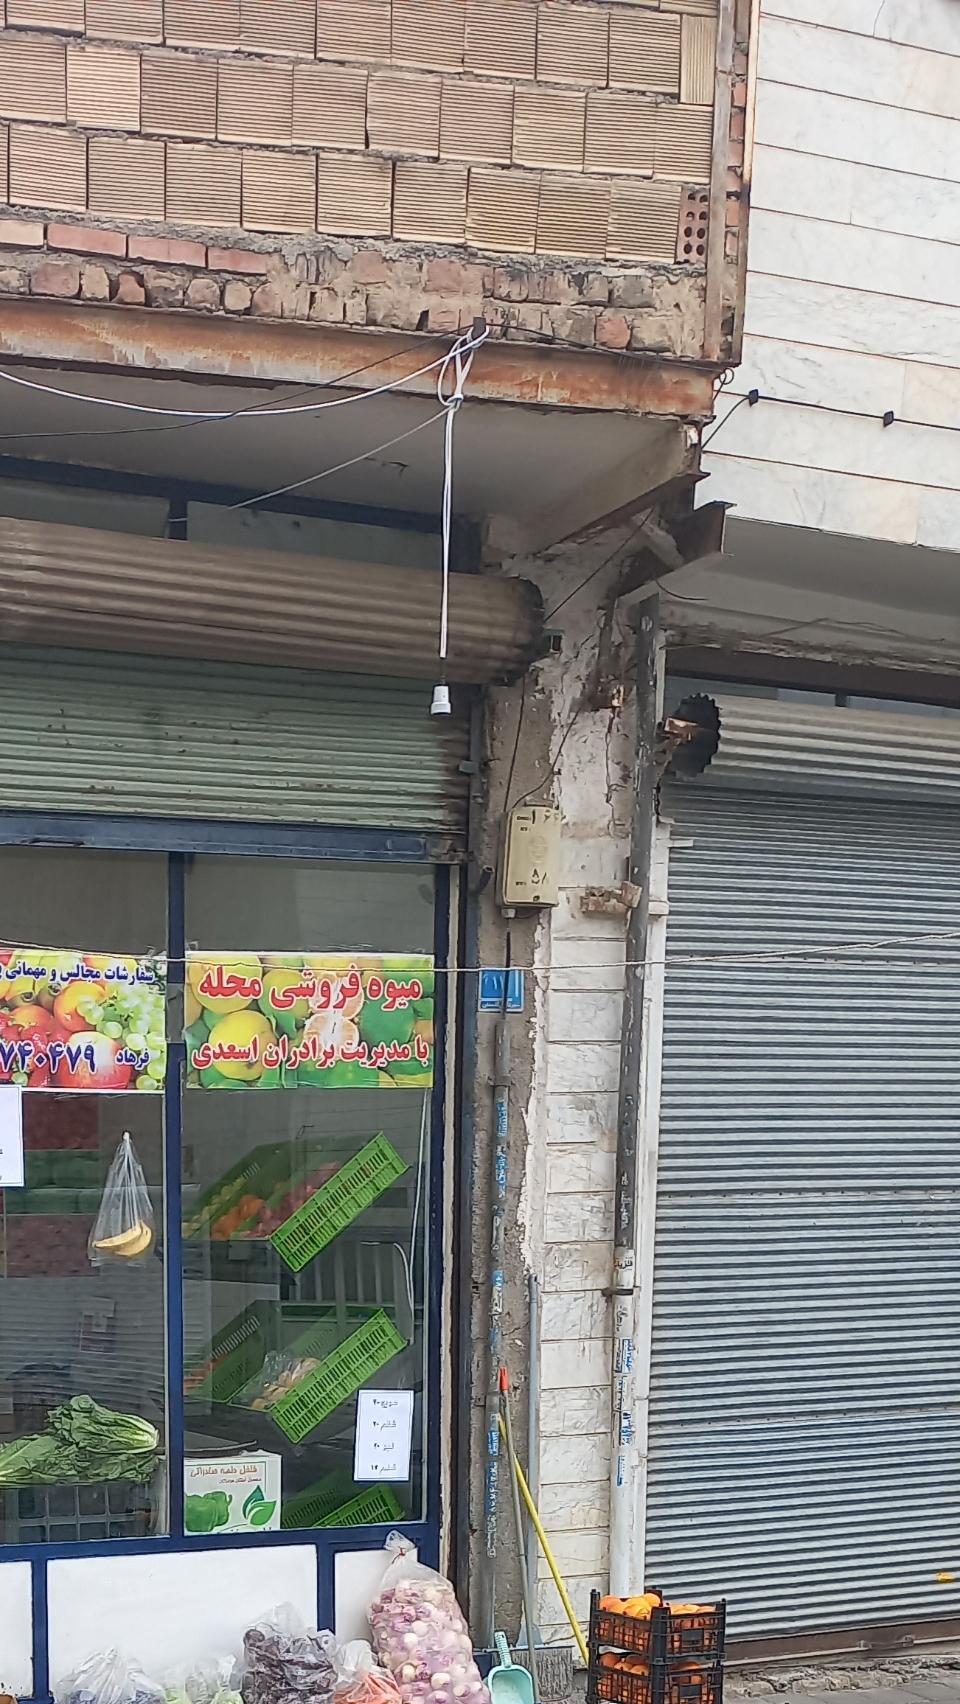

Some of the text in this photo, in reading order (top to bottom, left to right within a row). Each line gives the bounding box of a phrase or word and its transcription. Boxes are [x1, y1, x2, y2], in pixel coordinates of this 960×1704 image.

[6, 963, 47, 981] مهمانی
[49, 969, 58, 982] و
[60, 967, 101, 984] مجالس
[104, 965, 155, 985] سفارشات
[198, 963, 423, 1010] میوه فروشی محله
[115, 1046, 151, 1067] فرهاد
[192, 1034, 429, 1069] با مدیریت برادران اسعدی
